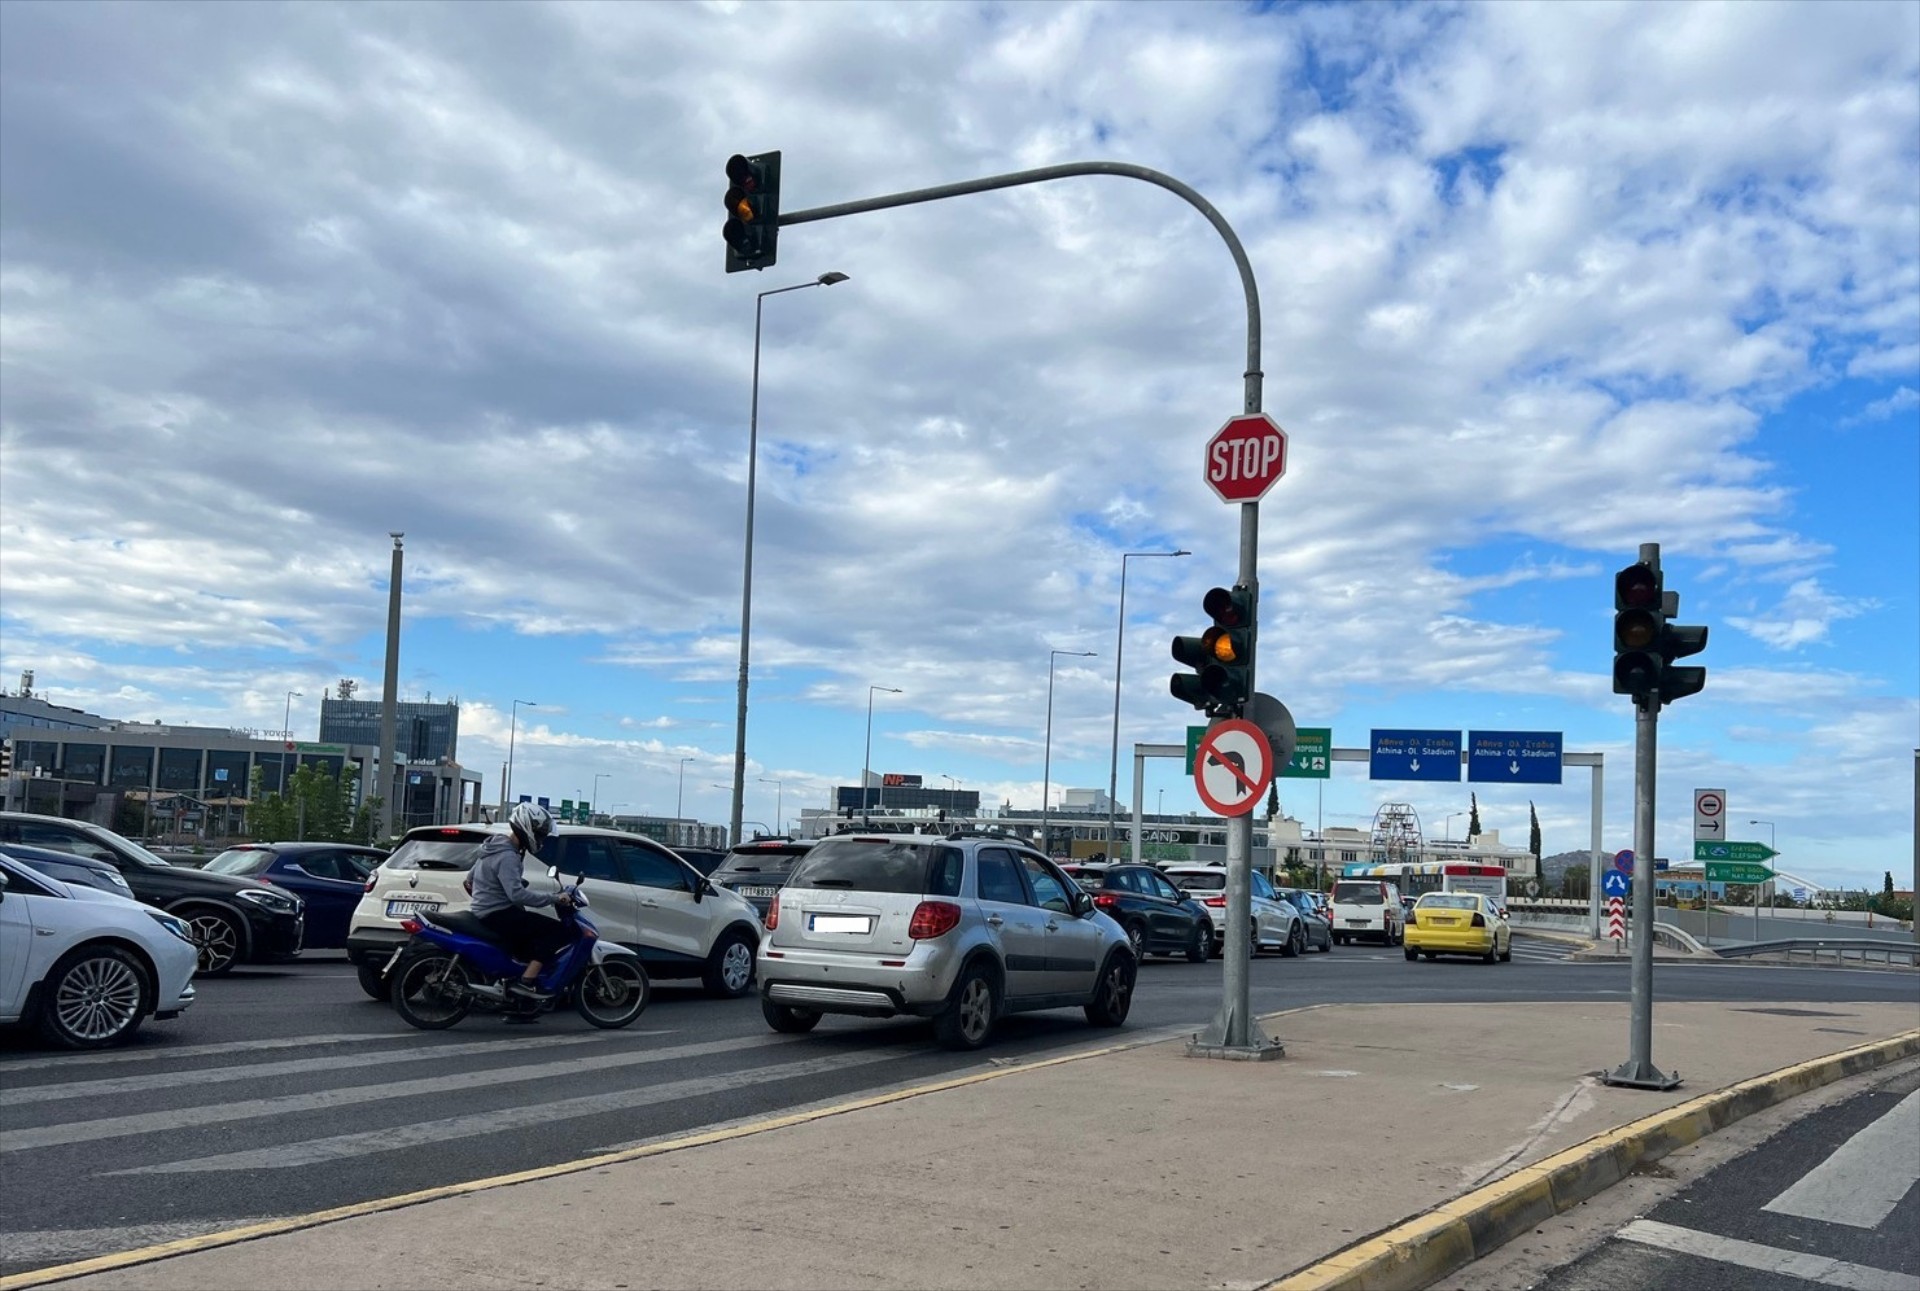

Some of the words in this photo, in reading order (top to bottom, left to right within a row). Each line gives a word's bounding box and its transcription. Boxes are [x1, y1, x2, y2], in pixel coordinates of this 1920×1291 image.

[1211, 435, 1280, 482] STOP
[1422, 747, 1456, 756] Stadium
[1474, 748, 1501, 756] Athina
[1522, 749, 1556, 758] Stadium
[884, 775, 905, 785] NP
